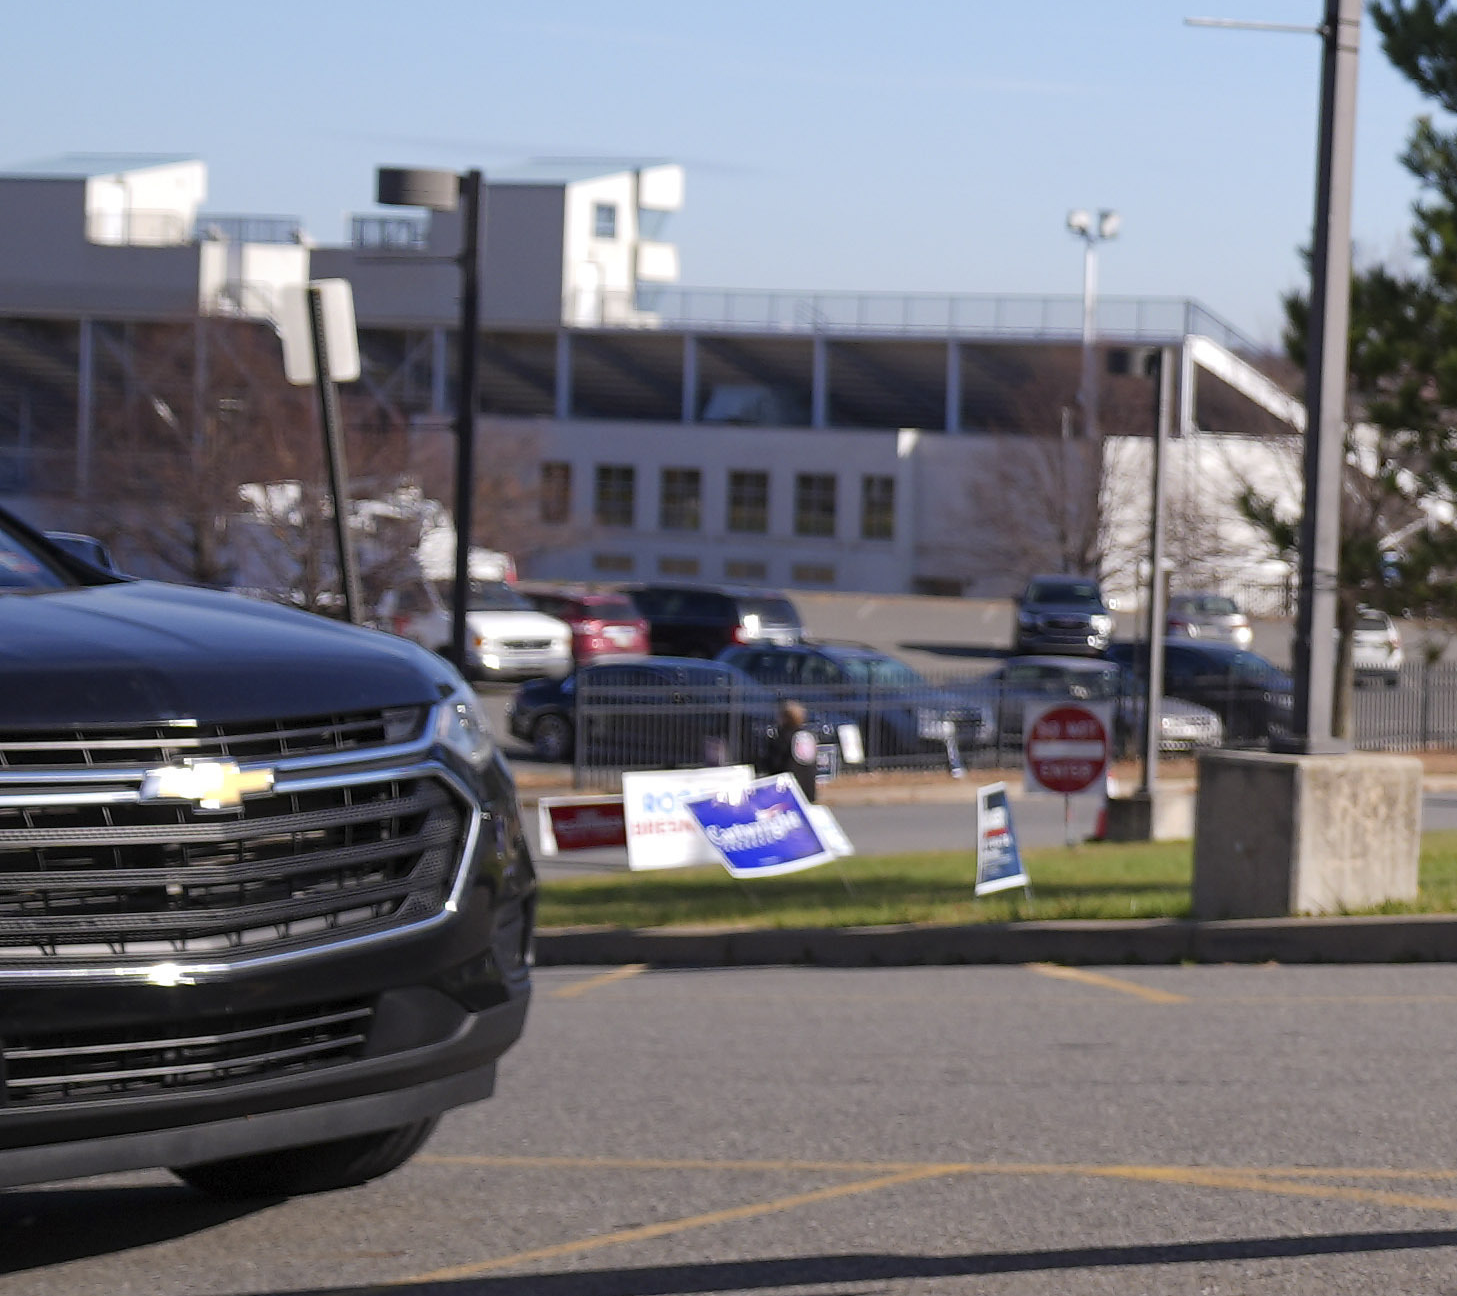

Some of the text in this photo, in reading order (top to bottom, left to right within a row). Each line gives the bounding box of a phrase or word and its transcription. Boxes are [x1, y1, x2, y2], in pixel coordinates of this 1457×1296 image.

[1037, 720, 1098, 737] DO NOT
[1041, 763, 1092, 777] ENTER
